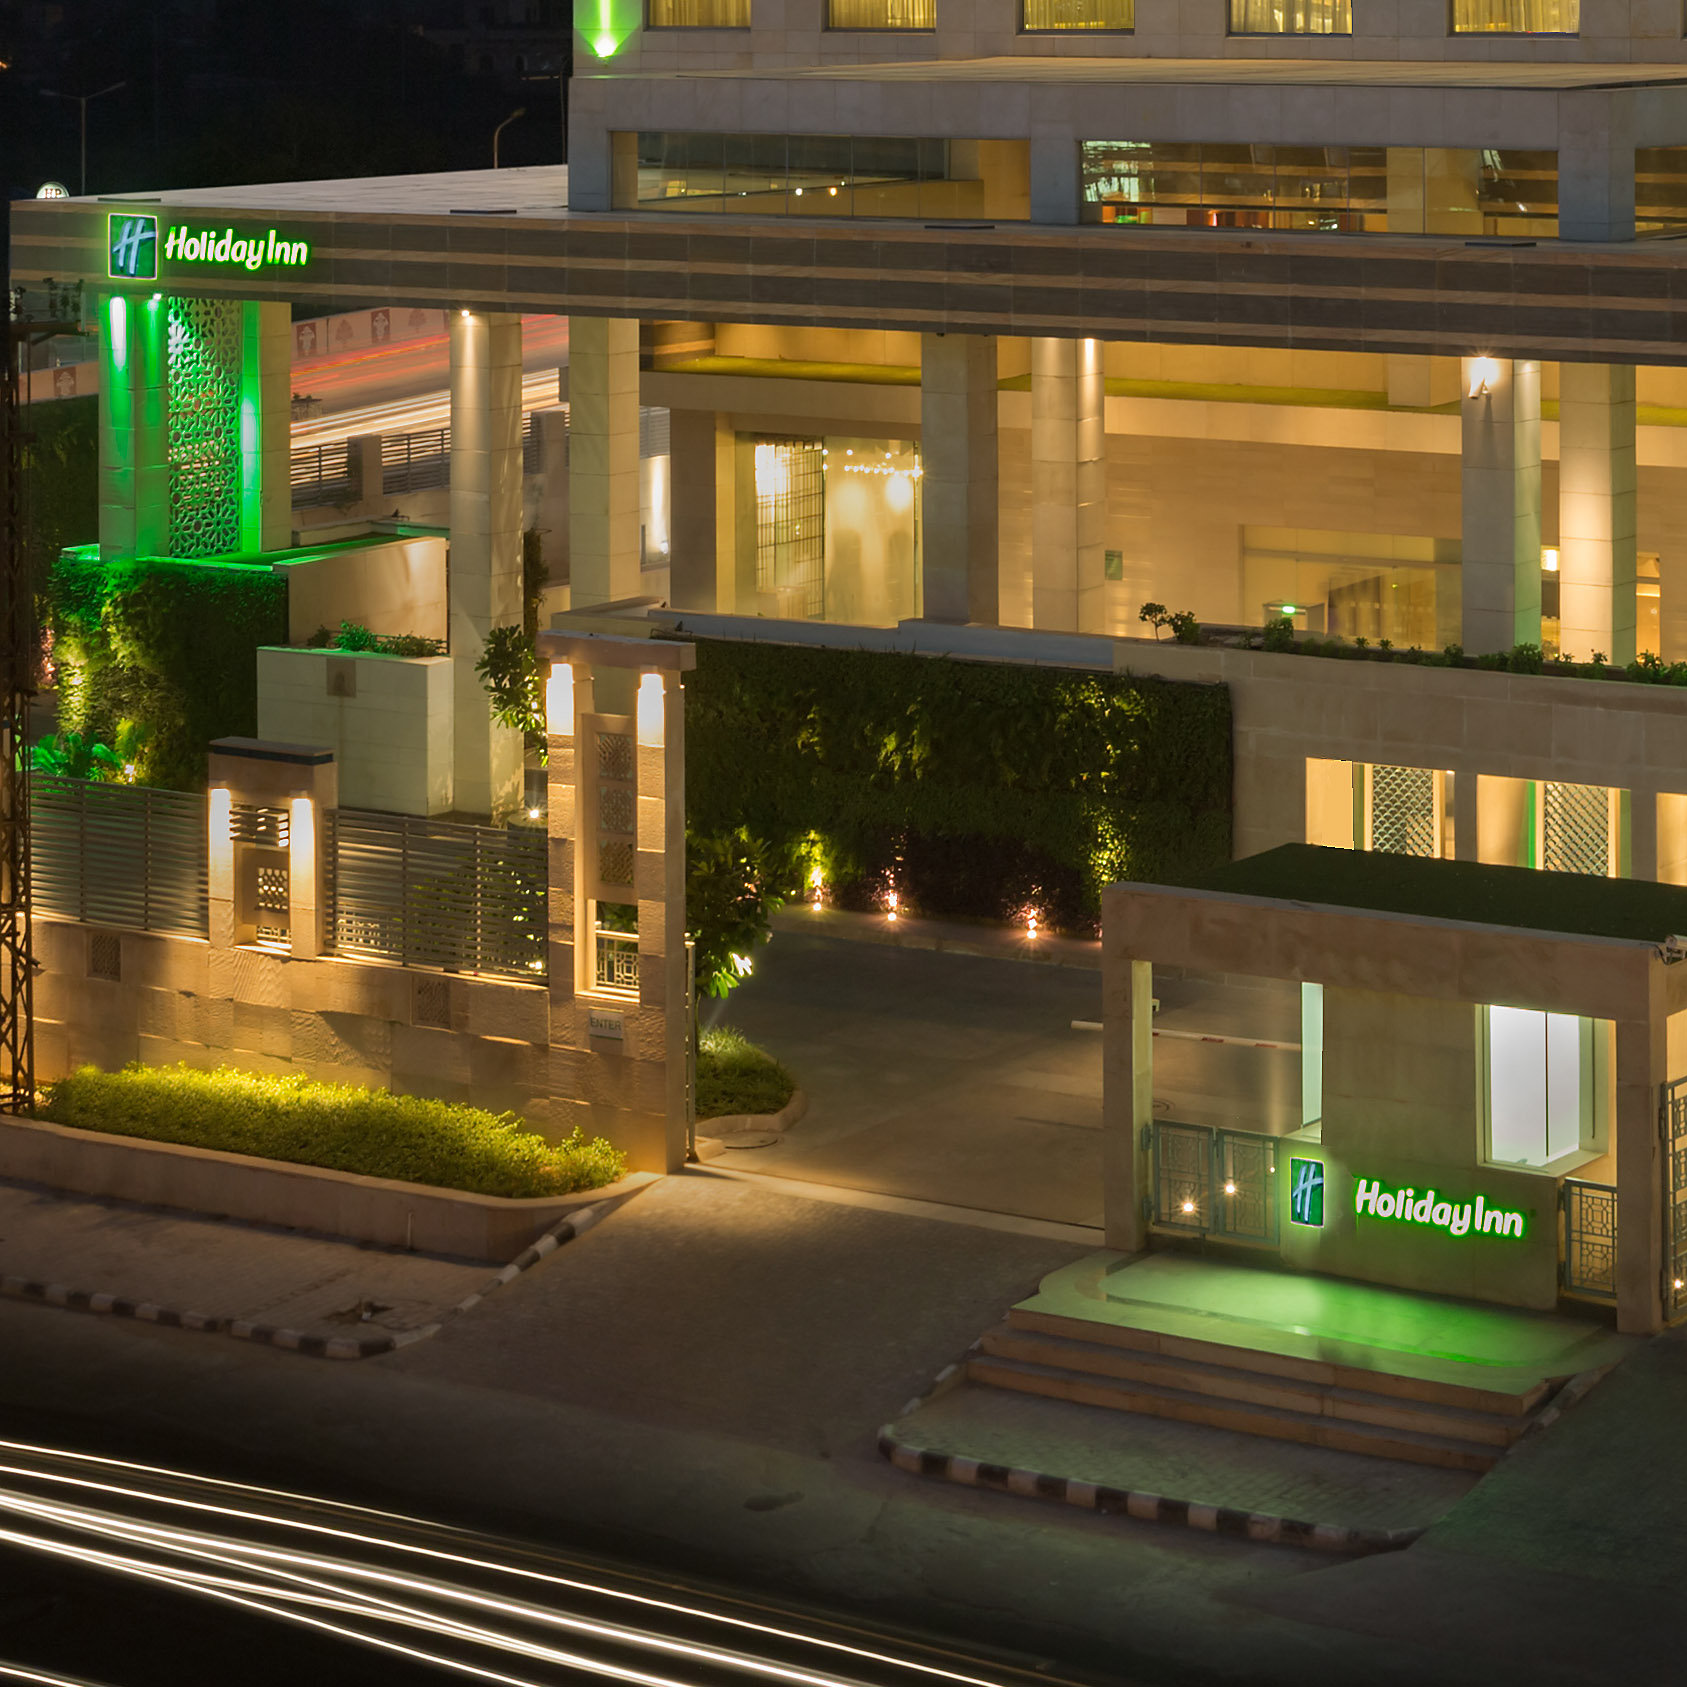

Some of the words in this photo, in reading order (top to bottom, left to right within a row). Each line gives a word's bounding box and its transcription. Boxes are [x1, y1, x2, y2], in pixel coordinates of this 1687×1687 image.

[165, 226, 265, 270] Holiday
[267, 230, 308, 265] Inn
[590, 1016, 622, 1031] ENTER
[1355, 1178, 1472, 1236] Holiday
[1475, 1195, 1524, 1237] Inn
